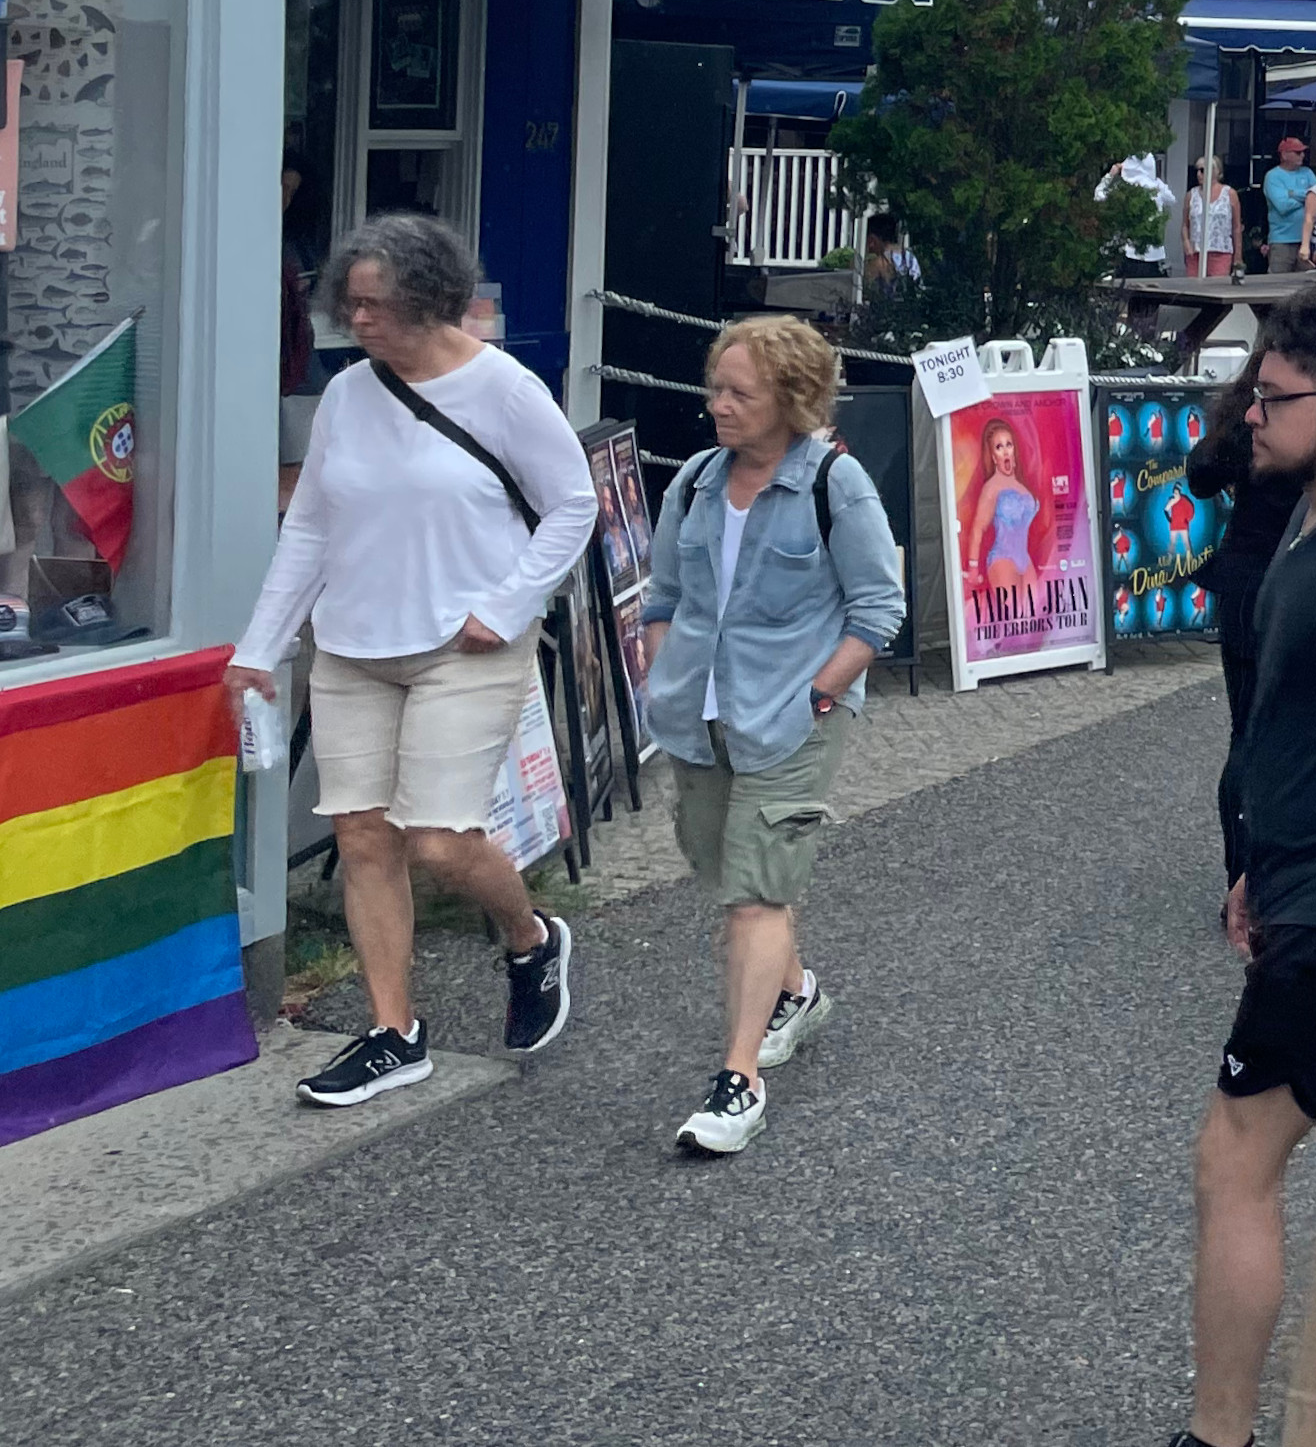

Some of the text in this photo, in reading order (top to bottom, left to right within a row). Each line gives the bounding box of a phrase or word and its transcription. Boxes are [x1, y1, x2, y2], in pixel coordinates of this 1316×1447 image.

[524, 120, 559, 151] 247
[918, 345, 971, 374] TONIGHT
[936, 366, 965, 384] 8:30
[1145, 458, 1159, 471] The
[1129, 545, 1214, 596] Dina Marti
[971, 575, 1090, 625] VARLA JEAN
[973, 612, 1088, 642] THE ERRORS TOUR
